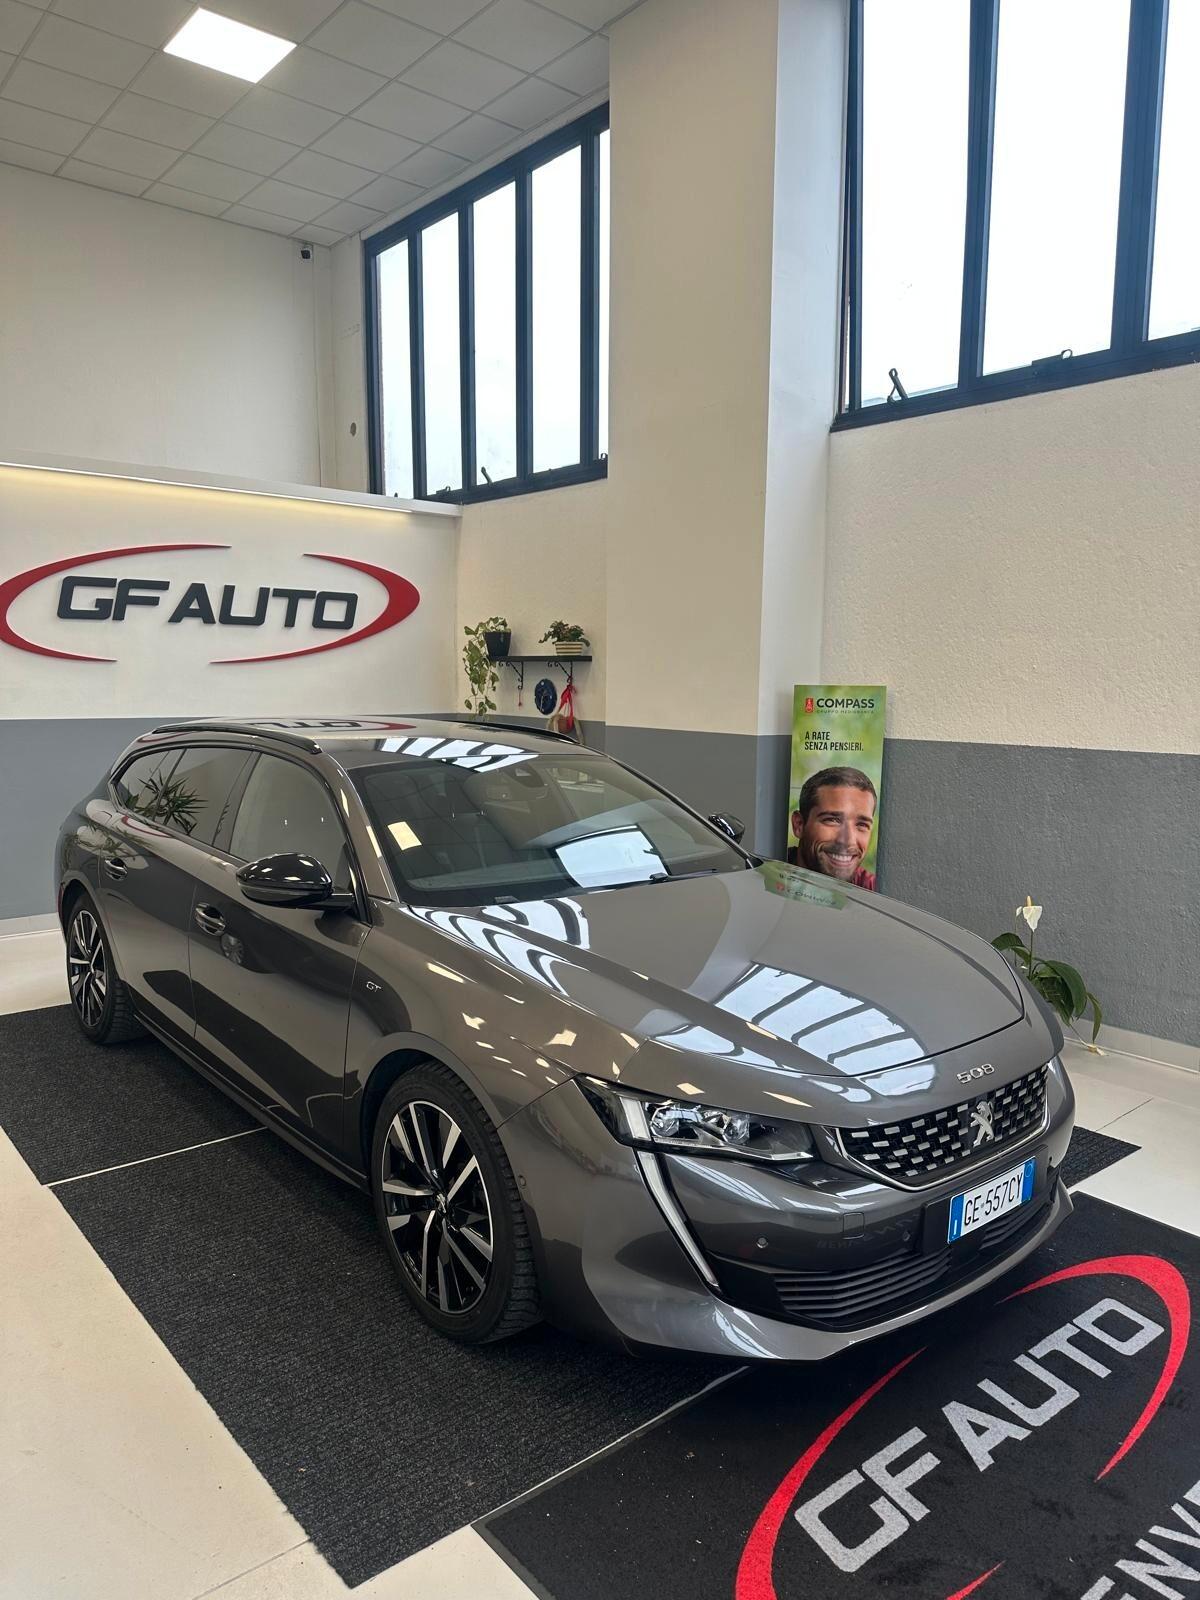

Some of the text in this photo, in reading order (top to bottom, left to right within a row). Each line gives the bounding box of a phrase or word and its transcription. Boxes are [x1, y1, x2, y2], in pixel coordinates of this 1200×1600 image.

[57, 575, 359, 630] GF AUTO
[816, 698, 875, 709] COMPASS
[804, 731, 831, 741] A RATE
[804, 741, 864, 752] SENZA PENSIERI.
[366, 981, 382, 993] GT
[957, 1063, 995, 1084] 508
[794, 1297, 1165, 1573] GF AUTO
